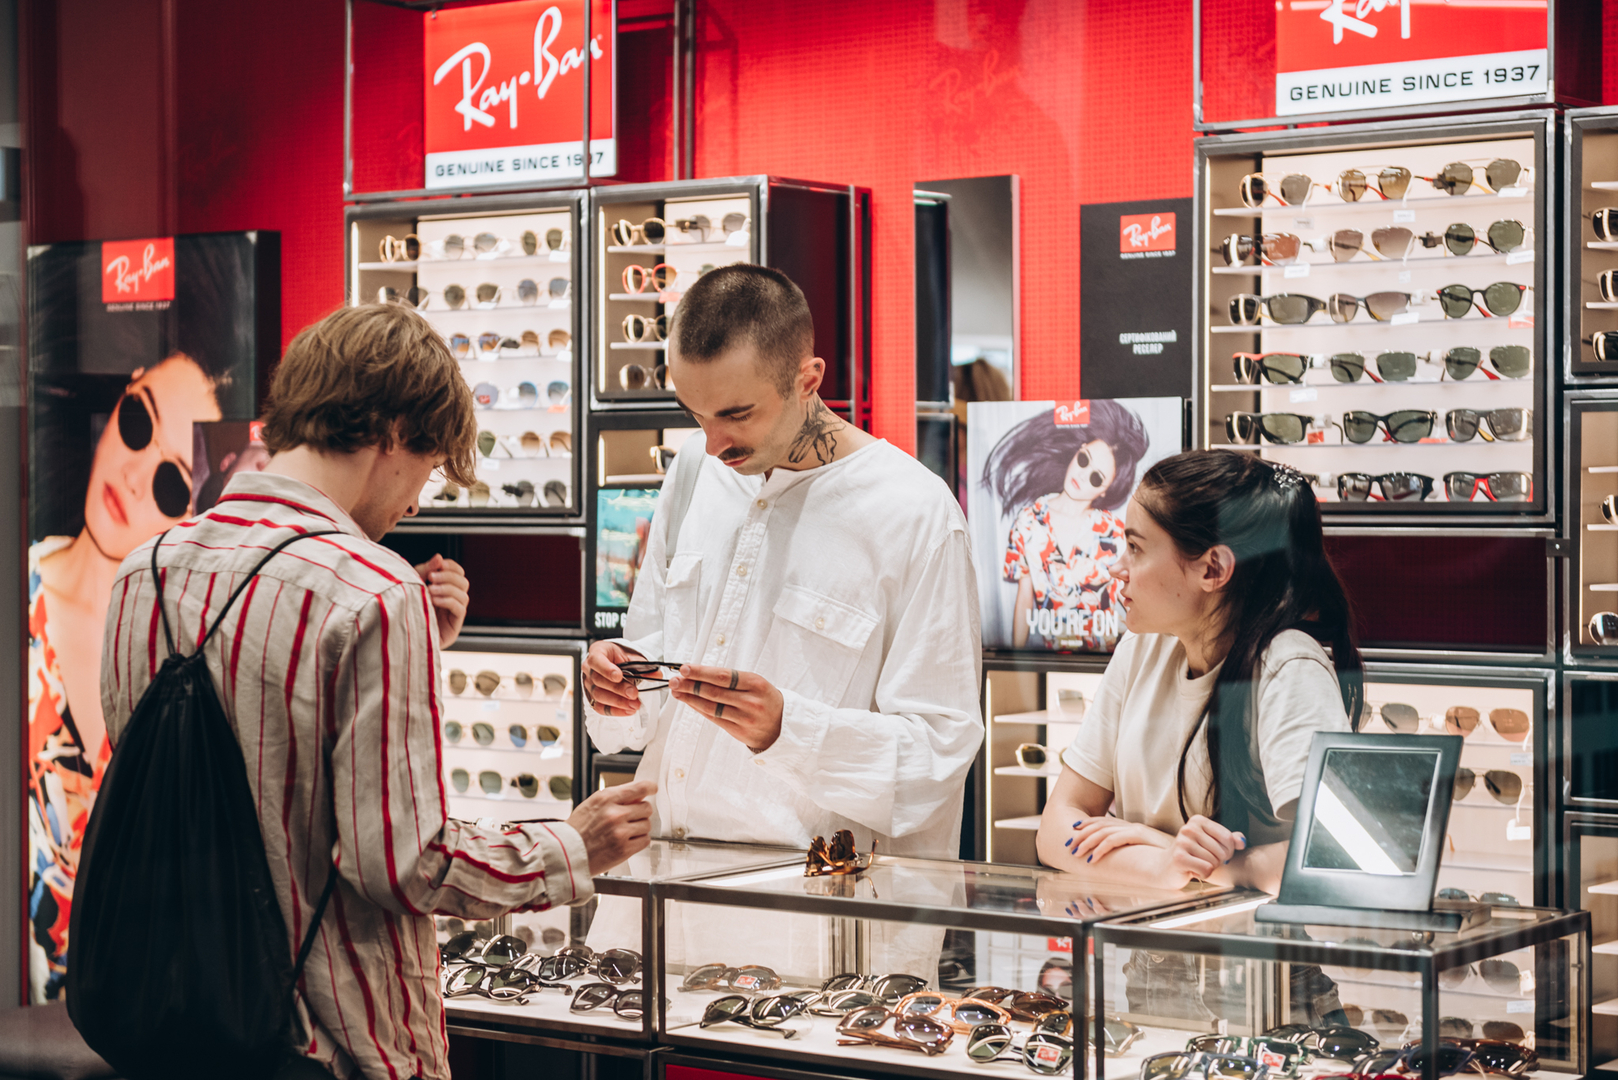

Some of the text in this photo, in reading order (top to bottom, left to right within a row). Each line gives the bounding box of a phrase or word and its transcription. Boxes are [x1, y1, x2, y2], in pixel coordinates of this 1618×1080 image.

[1290, 64, 1540, 101] GENUINE SINCE 1937
[435, 152, 604, 177] GENUINE SINCE 197
[595, 611, 620, 628] STOP
[1026, 608, 1118, 637] YOU'RE ON
